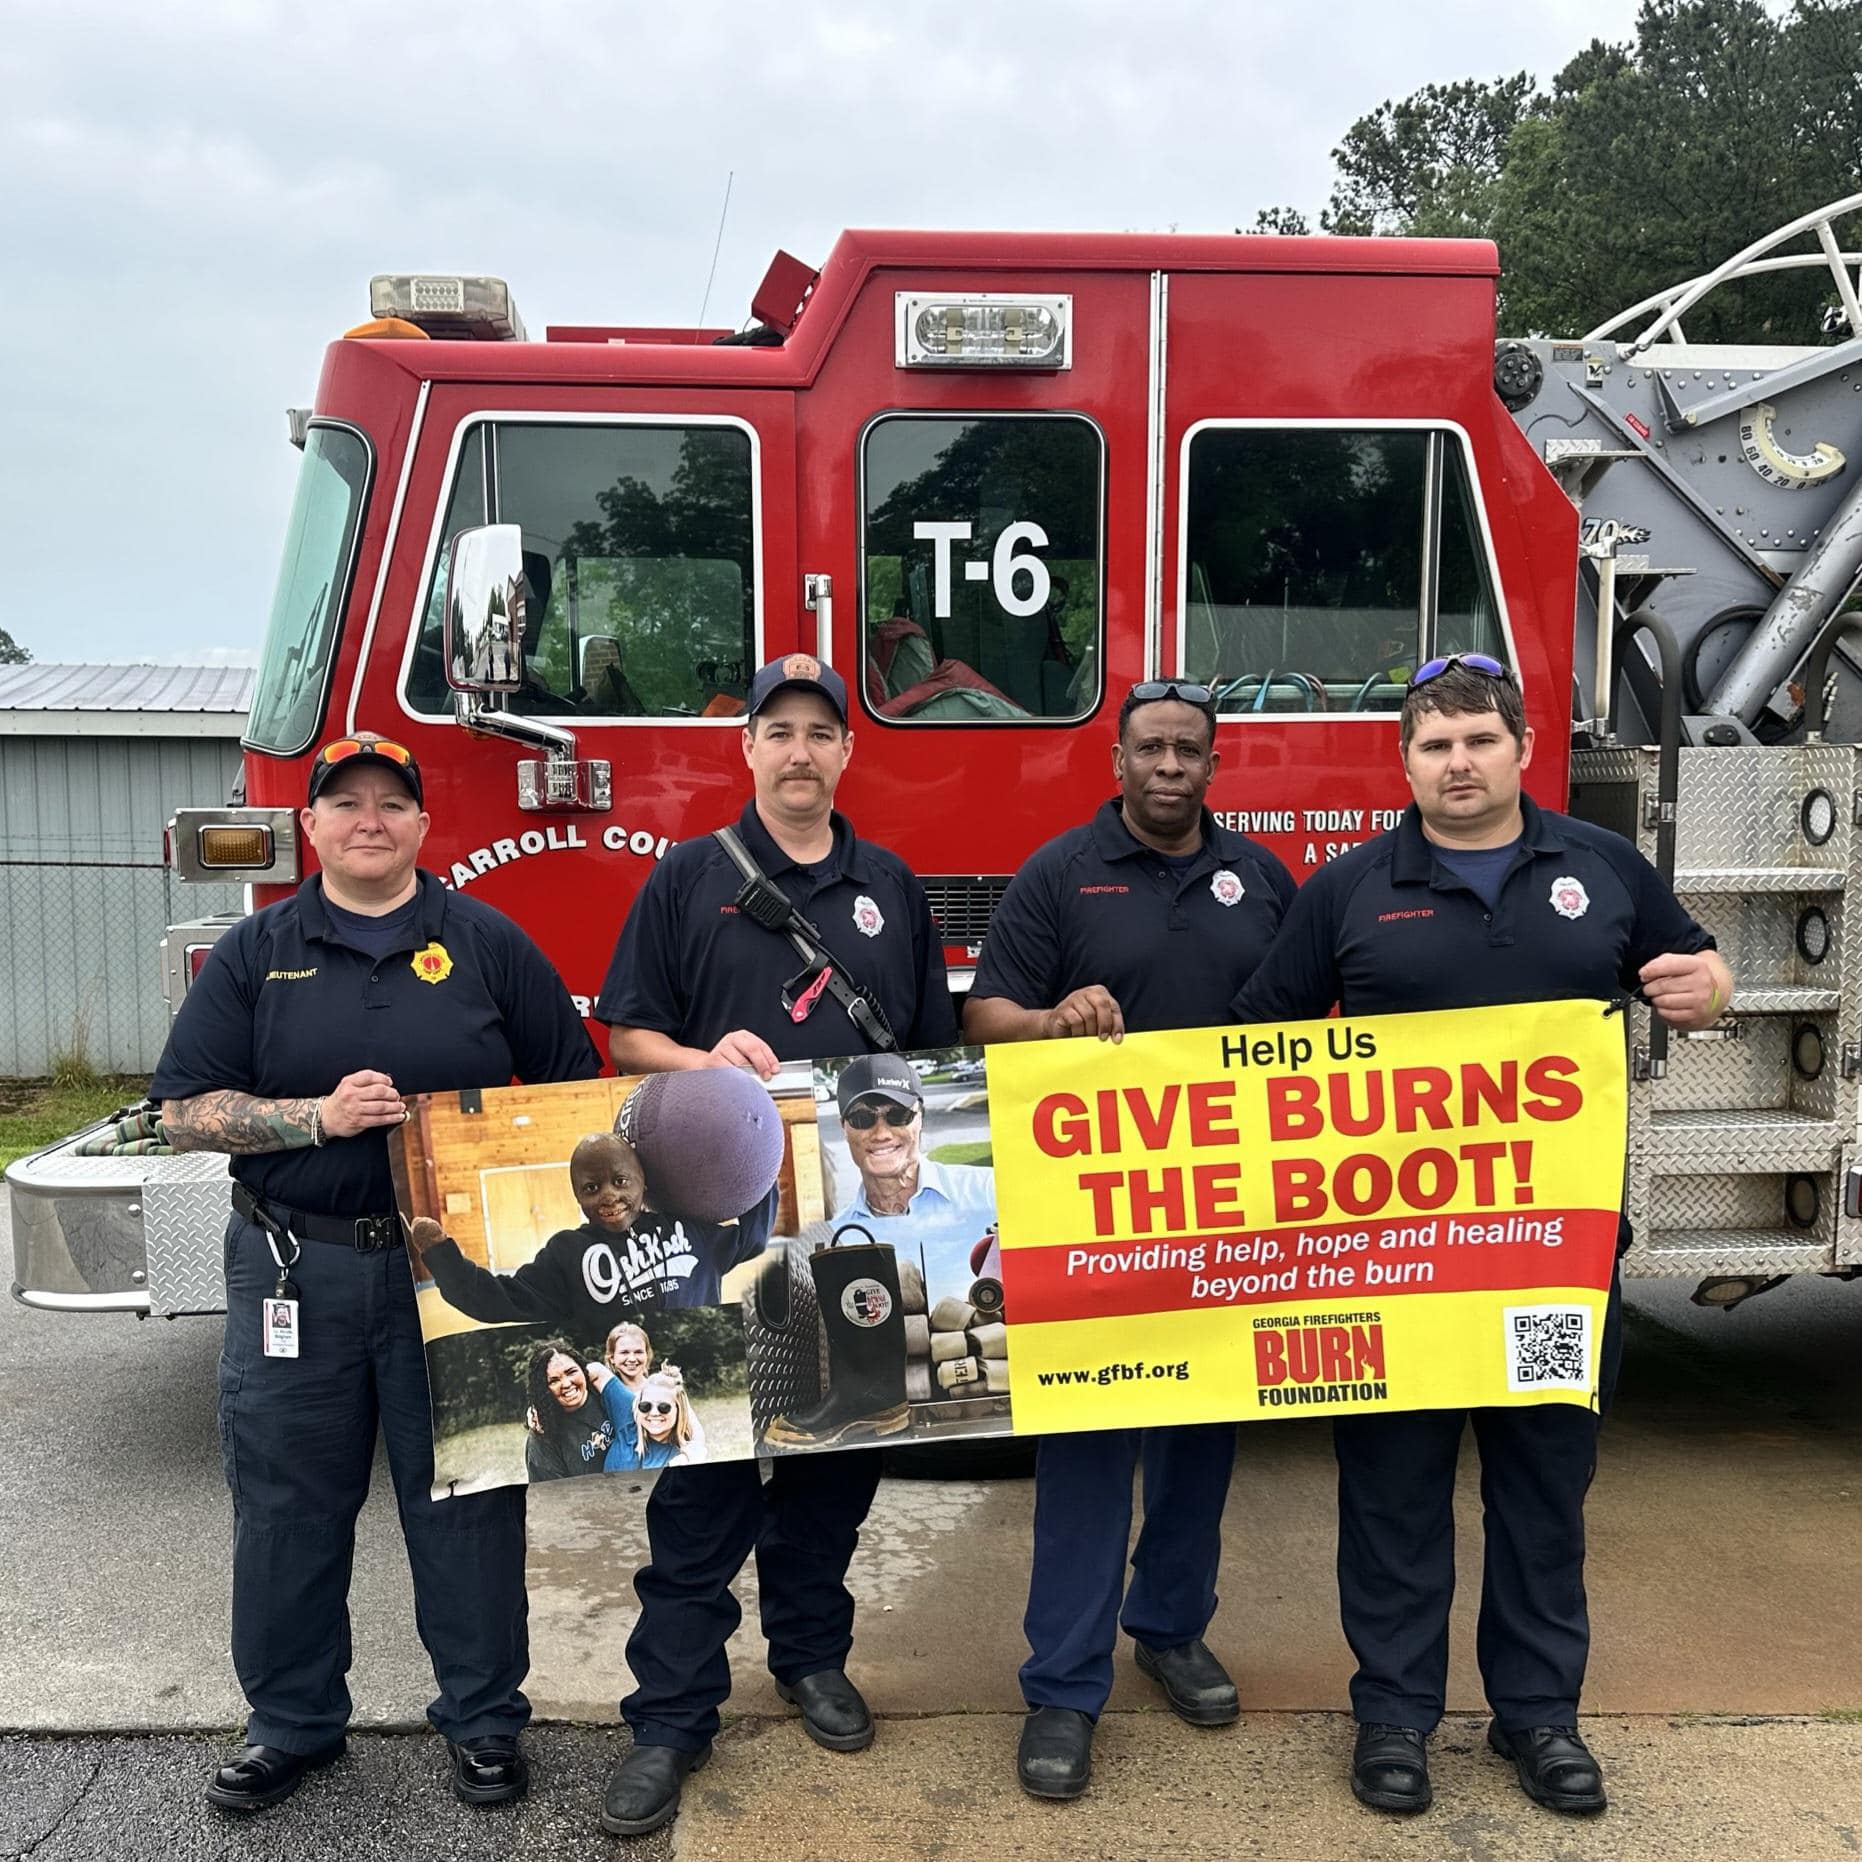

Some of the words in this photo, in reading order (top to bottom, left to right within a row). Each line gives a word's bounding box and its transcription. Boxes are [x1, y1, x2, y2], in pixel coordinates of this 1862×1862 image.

[1741, 426, 1752, 440] 80
[1746, 446, 1760, 460] 60
[1758, 464, 1773, 477] 40
[1774, 476, 1790, 486] 20
[1582, 517, 1619, 546] 70
[913, 520, 1051, 618] T-6
[1213, 811, 1295, 832] SERVING
[1303, 810, 1364, 831] TODAY
[1304, 843, 1317, 864] A
[1080, 885, 1129, 895] FIREFIGHTER
[1378, 909, 1434, 922] FIREFIGHTER
[1222, 1030, 1312, 1071] Help
[1326, 1027, 1377, 1060] Us
[1032, 1080, 1240, 1158] GIVE
[1266, 1055, 1584, 1142] BURNS
[1079, 1162, 1245, 1237] THE
[1271, 1140, 1534, 1223] BOOT!
[1066, 1245, 1206, 1277] Providing
[1215, 1236, 1286, 1268] help,
[1296, 1230, 1371, 1266] hope
[1379, 1219, 1437, 1250] and
[1447, 1214, 1564, 1247] healing
[1191, 1266, 1298, 1301] beyond
[1307, 1263, 1356, 1289] the
[1365, 1259, 1434, 1286] burn
[1253, 1315, 1300, 1329] GEORGIA
[1303, 1311, 1381, 1326] FIREFIGHTERS
[1253, 1324, 1386, 1386] BURN
[1038, 1361, 1189, 1386] www.gfbf.org
[1258, 1382, 1387, 1407] FOUNDATION
